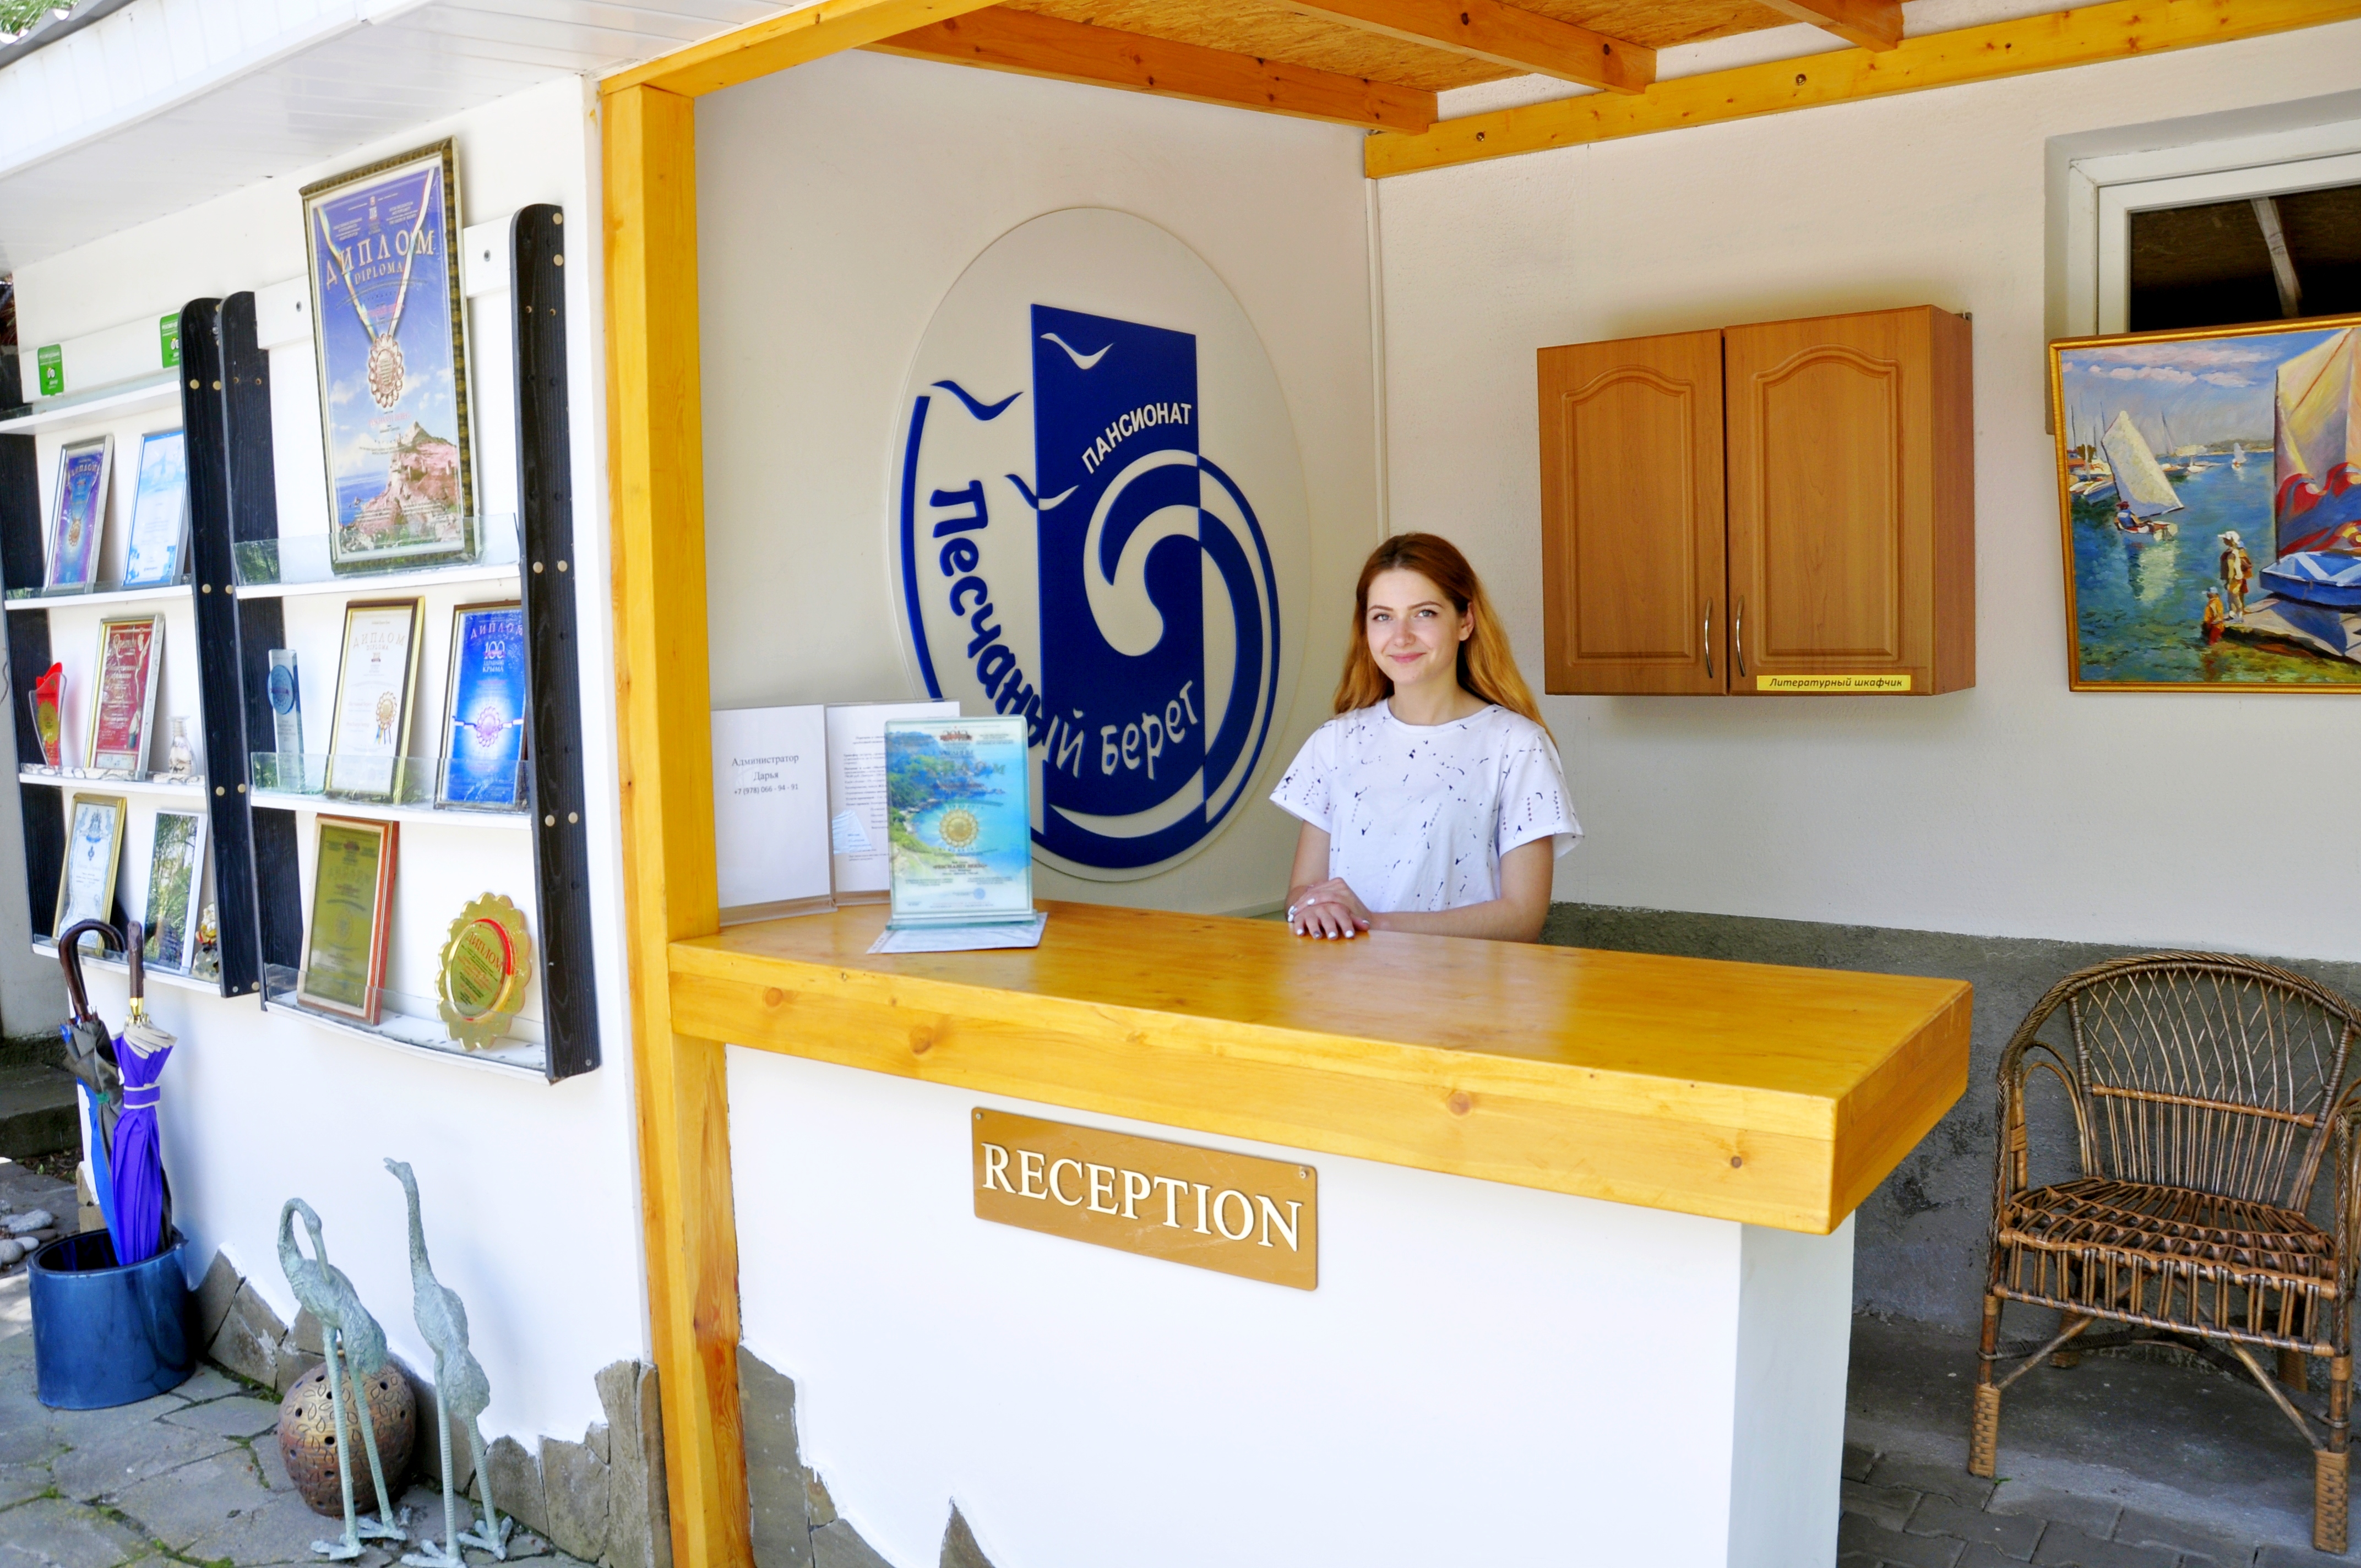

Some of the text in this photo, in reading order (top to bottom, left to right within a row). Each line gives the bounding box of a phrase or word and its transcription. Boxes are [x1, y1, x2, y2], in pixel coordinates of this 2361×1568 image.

[327, 229, 434, 290] ДИПЛОМ
[355, 261, 403, 285] DIPLOMA
[1081, 402, 1192, 474] ПАНСИОНАТ
[353, 632, 405, 649] ДИПЛОМ
[929, 479, 1086, 778] Песчаный
[1770, 678, 1902, 688] Литературный шкафчик
[732, 755, 799, 766] Администратор
[753, 772, 779, 781] Дарья
[743, 787, 759, 795] (978)
[465, 932, 502, 972] ДИПЛОМ
[981, 1142, 1304, 1253] RECEPTION
